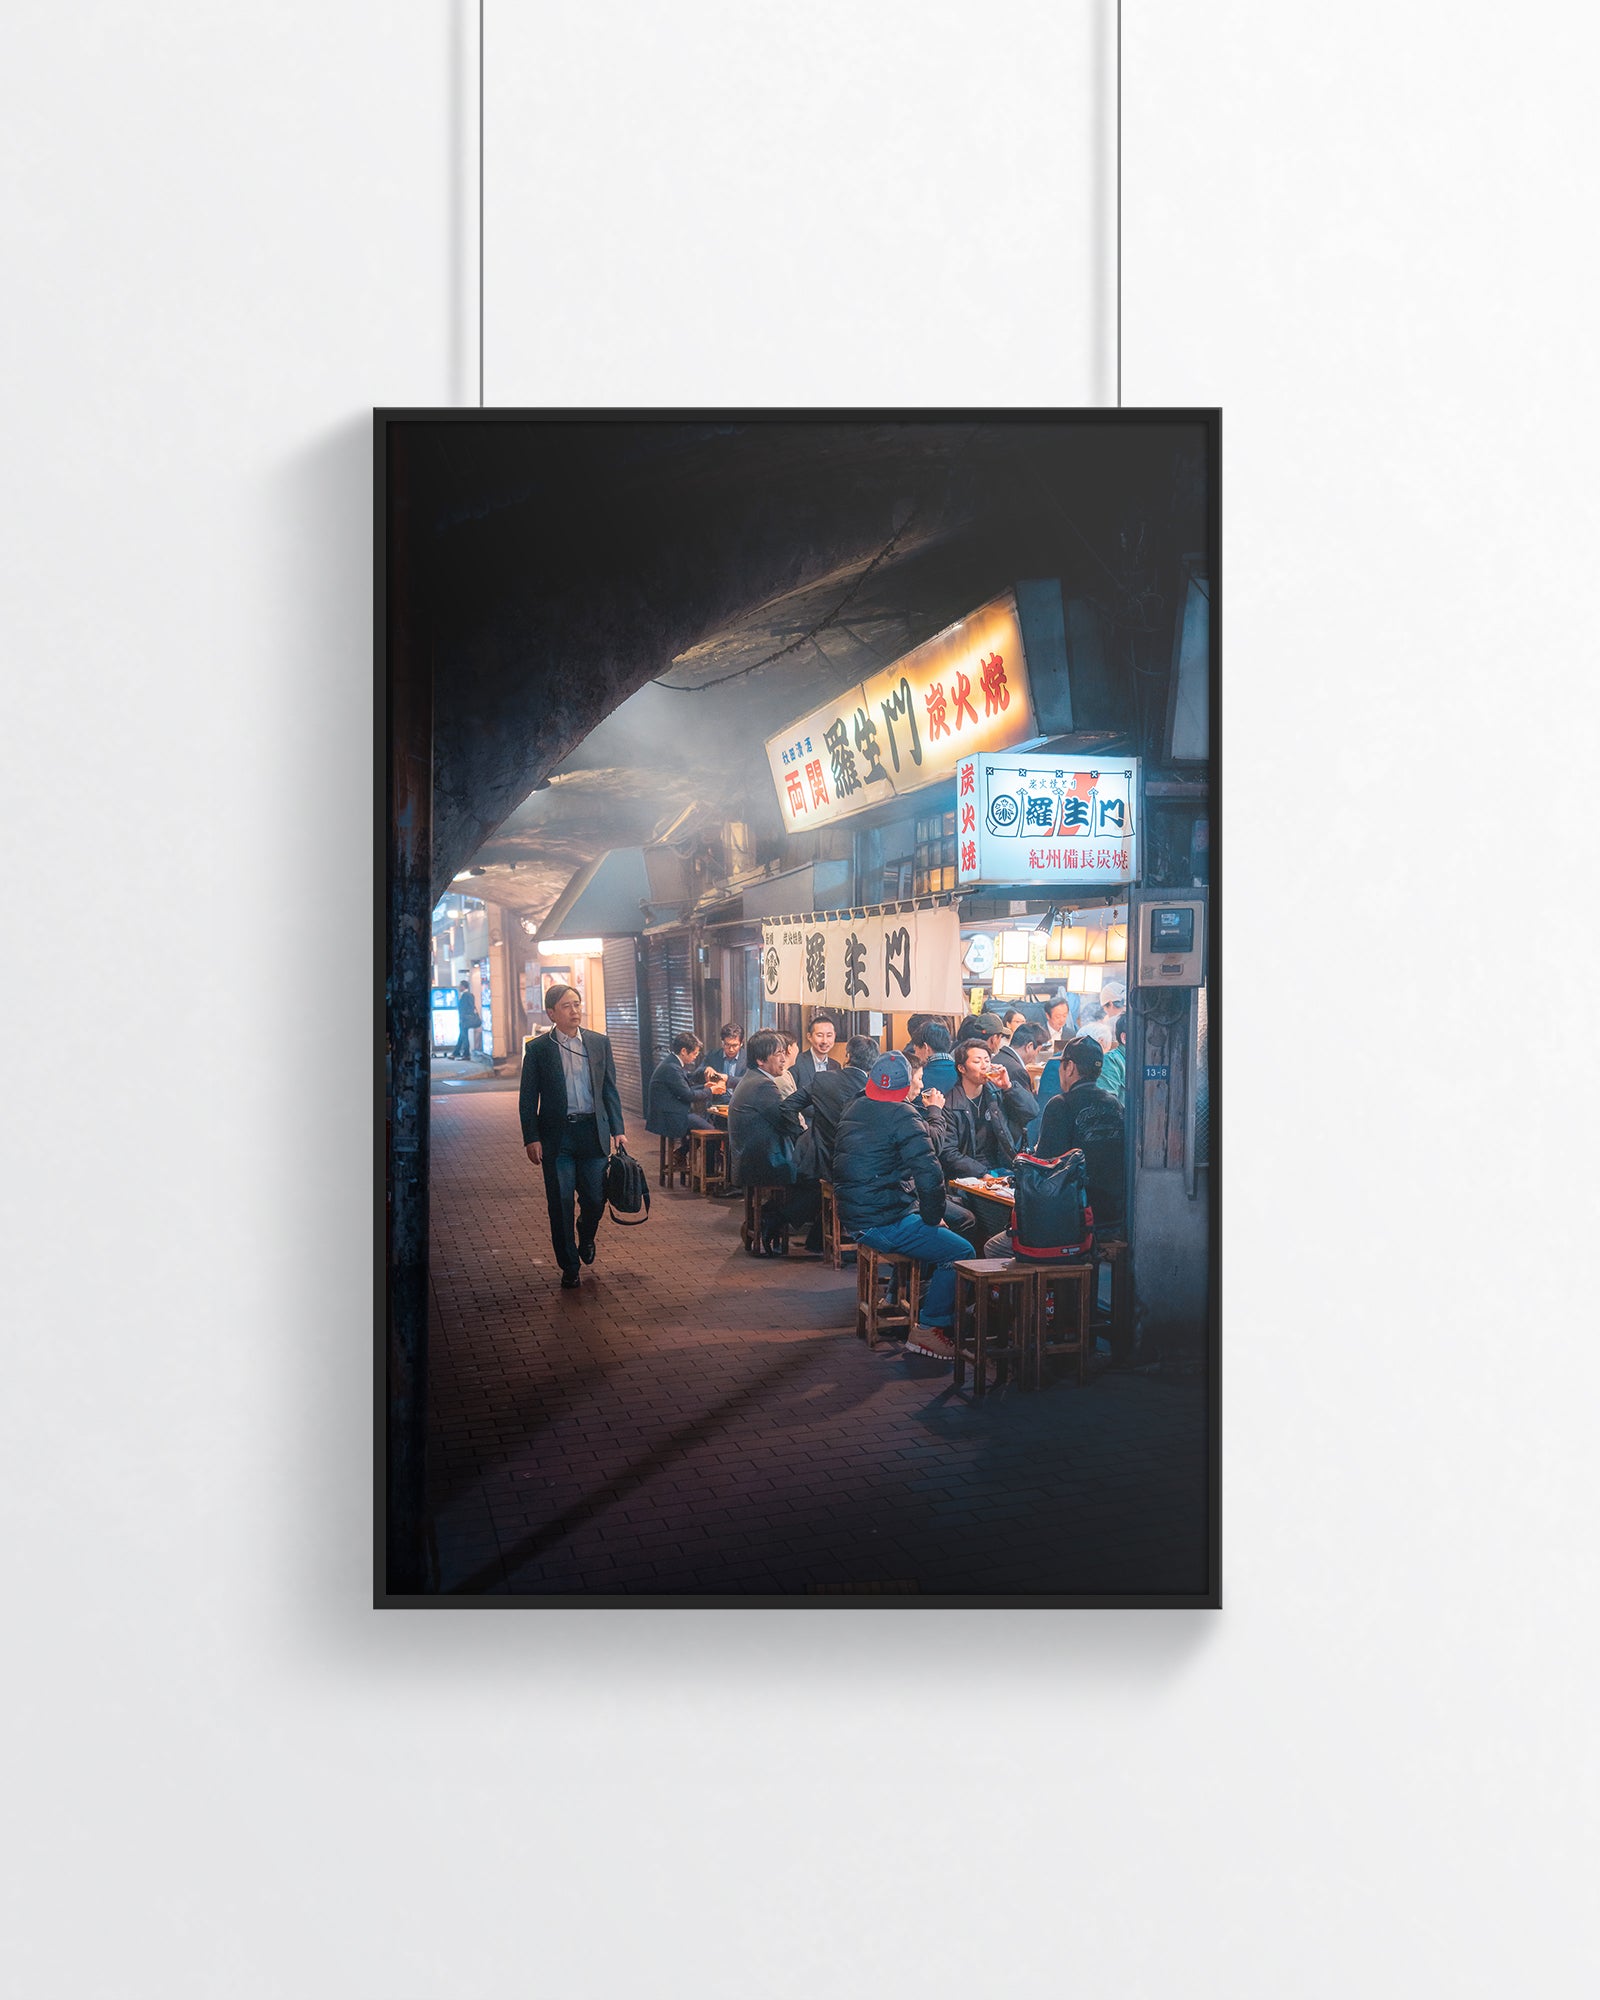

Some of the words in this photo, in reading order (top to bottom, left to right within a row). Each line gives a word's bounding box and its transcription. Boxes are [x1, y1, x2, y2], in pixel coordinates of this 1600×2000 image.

[823, 676, 923, 799] 羅生門
[924, 652, 1010, 742] 炭火焼
[960, 763, 977, 872] 炭火焼
[1025, 795, 1125, 828] 羅生門
[805, 926, 911, 998] 羅生門
[881, 1073, 891, 1089] B
[1146, 1068, 1167, 1077] 13-8
